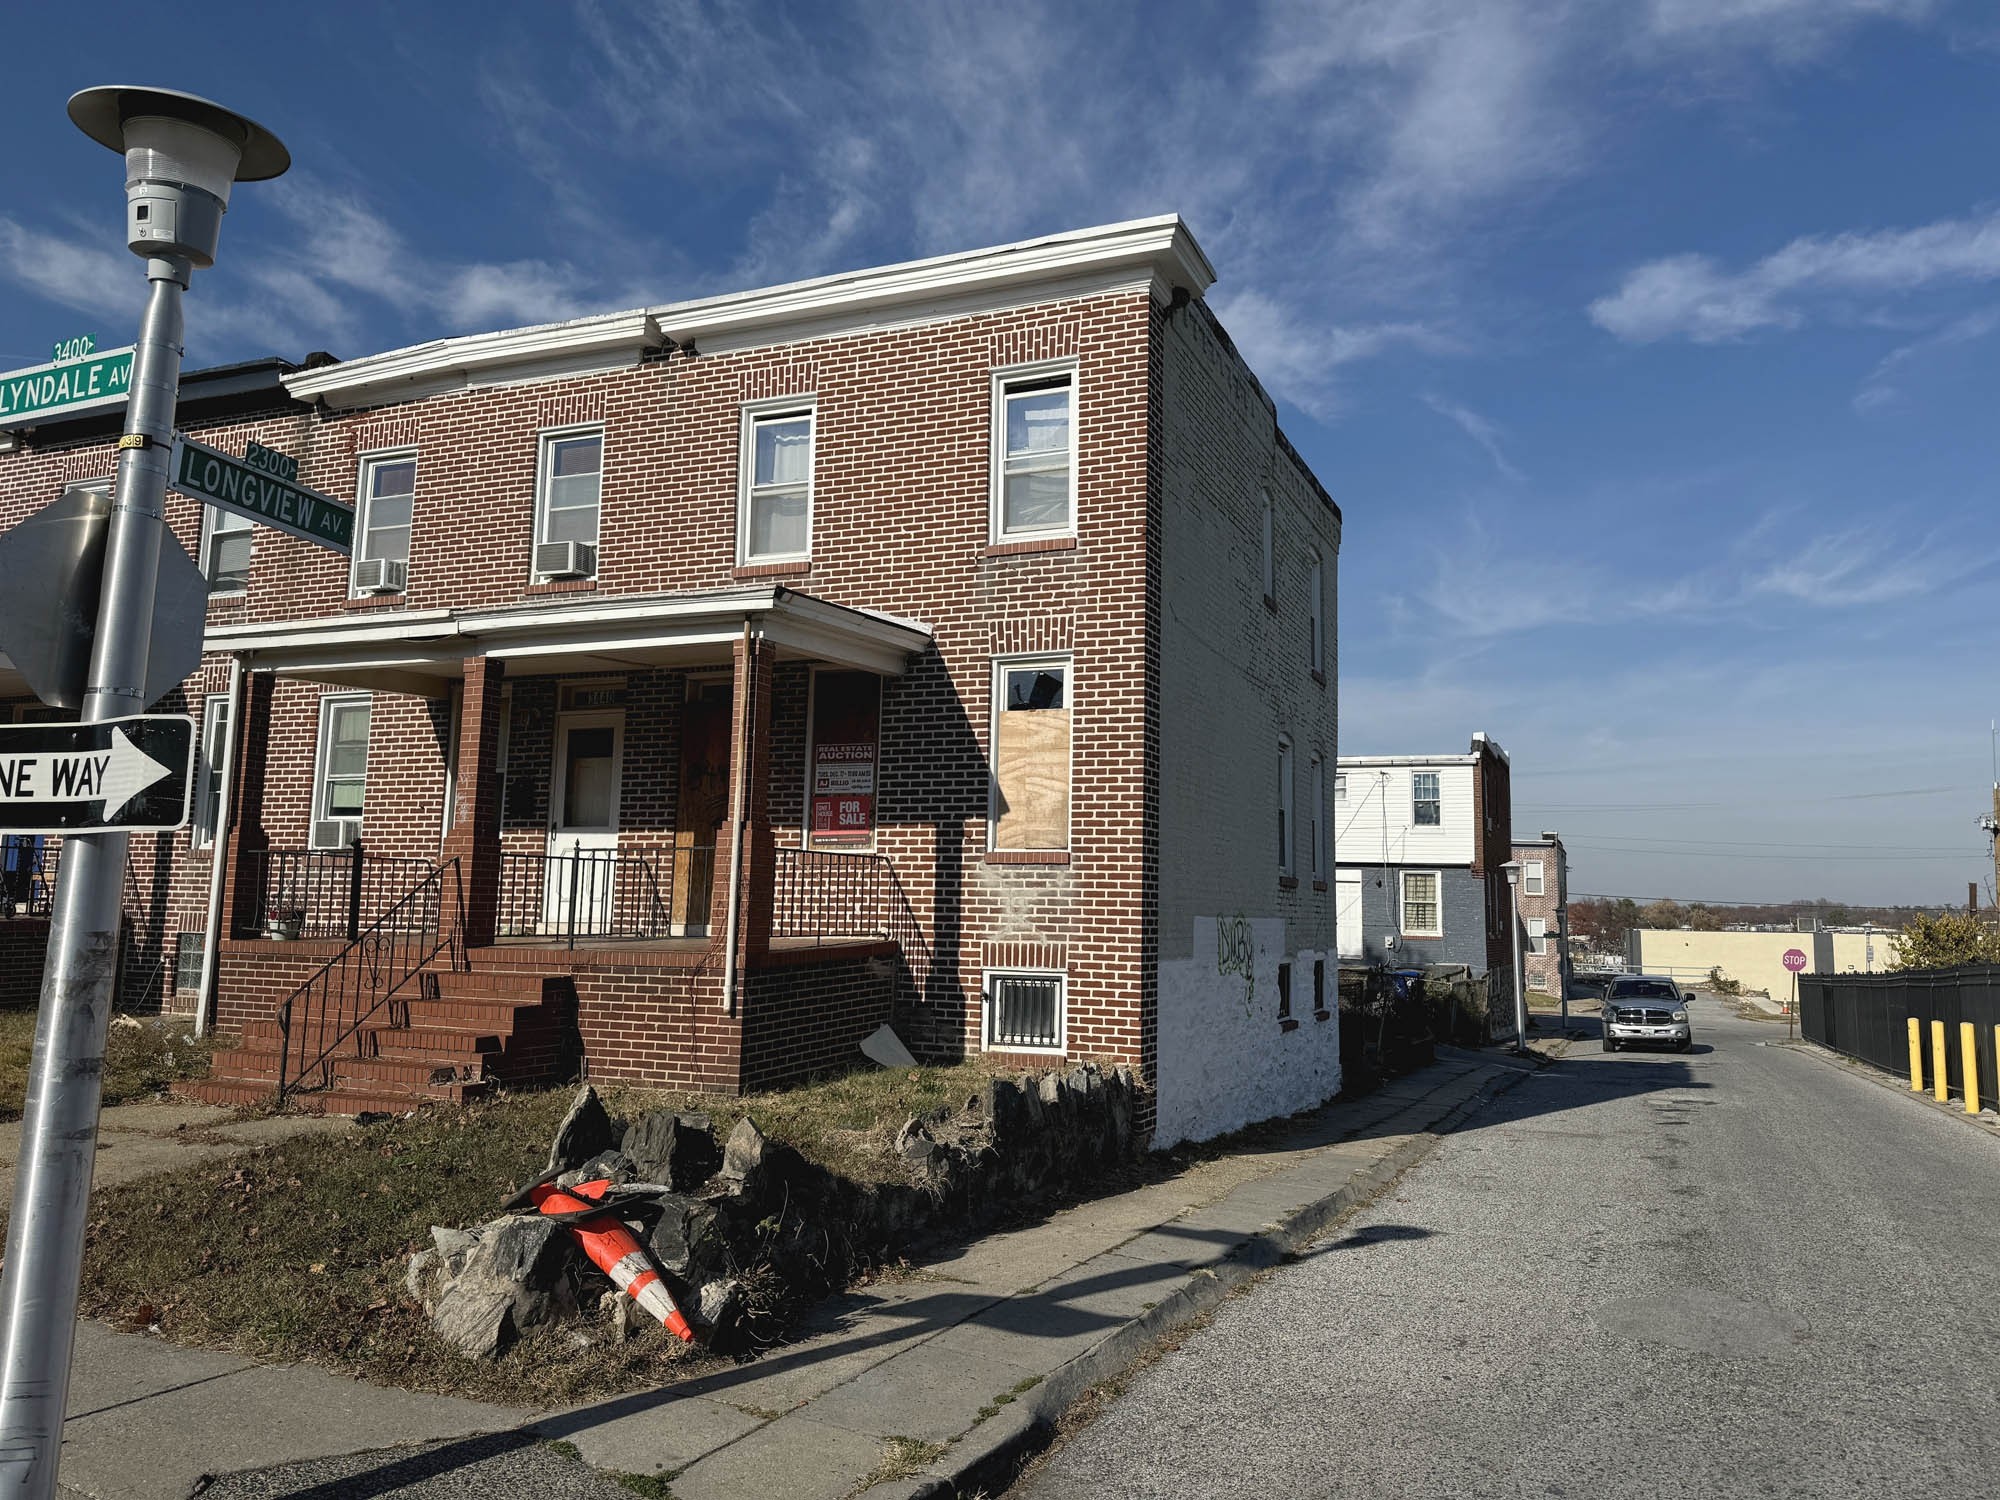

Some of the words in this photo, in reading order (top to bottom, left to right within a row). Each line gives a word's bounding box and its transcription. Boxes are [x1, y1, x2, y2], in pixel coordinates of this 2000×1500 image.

[53, 336, 89, 363] 3400
[0, 364, 103, 412] LYNDALE
[108, 364, 130, 387] AV
[249, 446, 290, 478] 2300
[185, 452, 314, 530] LONGVIEW
[320, 507, 344, 536] AV.
[819, 752, 872, 760] AUCTION
[52, 755, 110, 797] WAY
[840, 801, 860, 813] FOR
[840, 813, 865, 825] SALE
[1784, 955, 1805, 965] STOP
